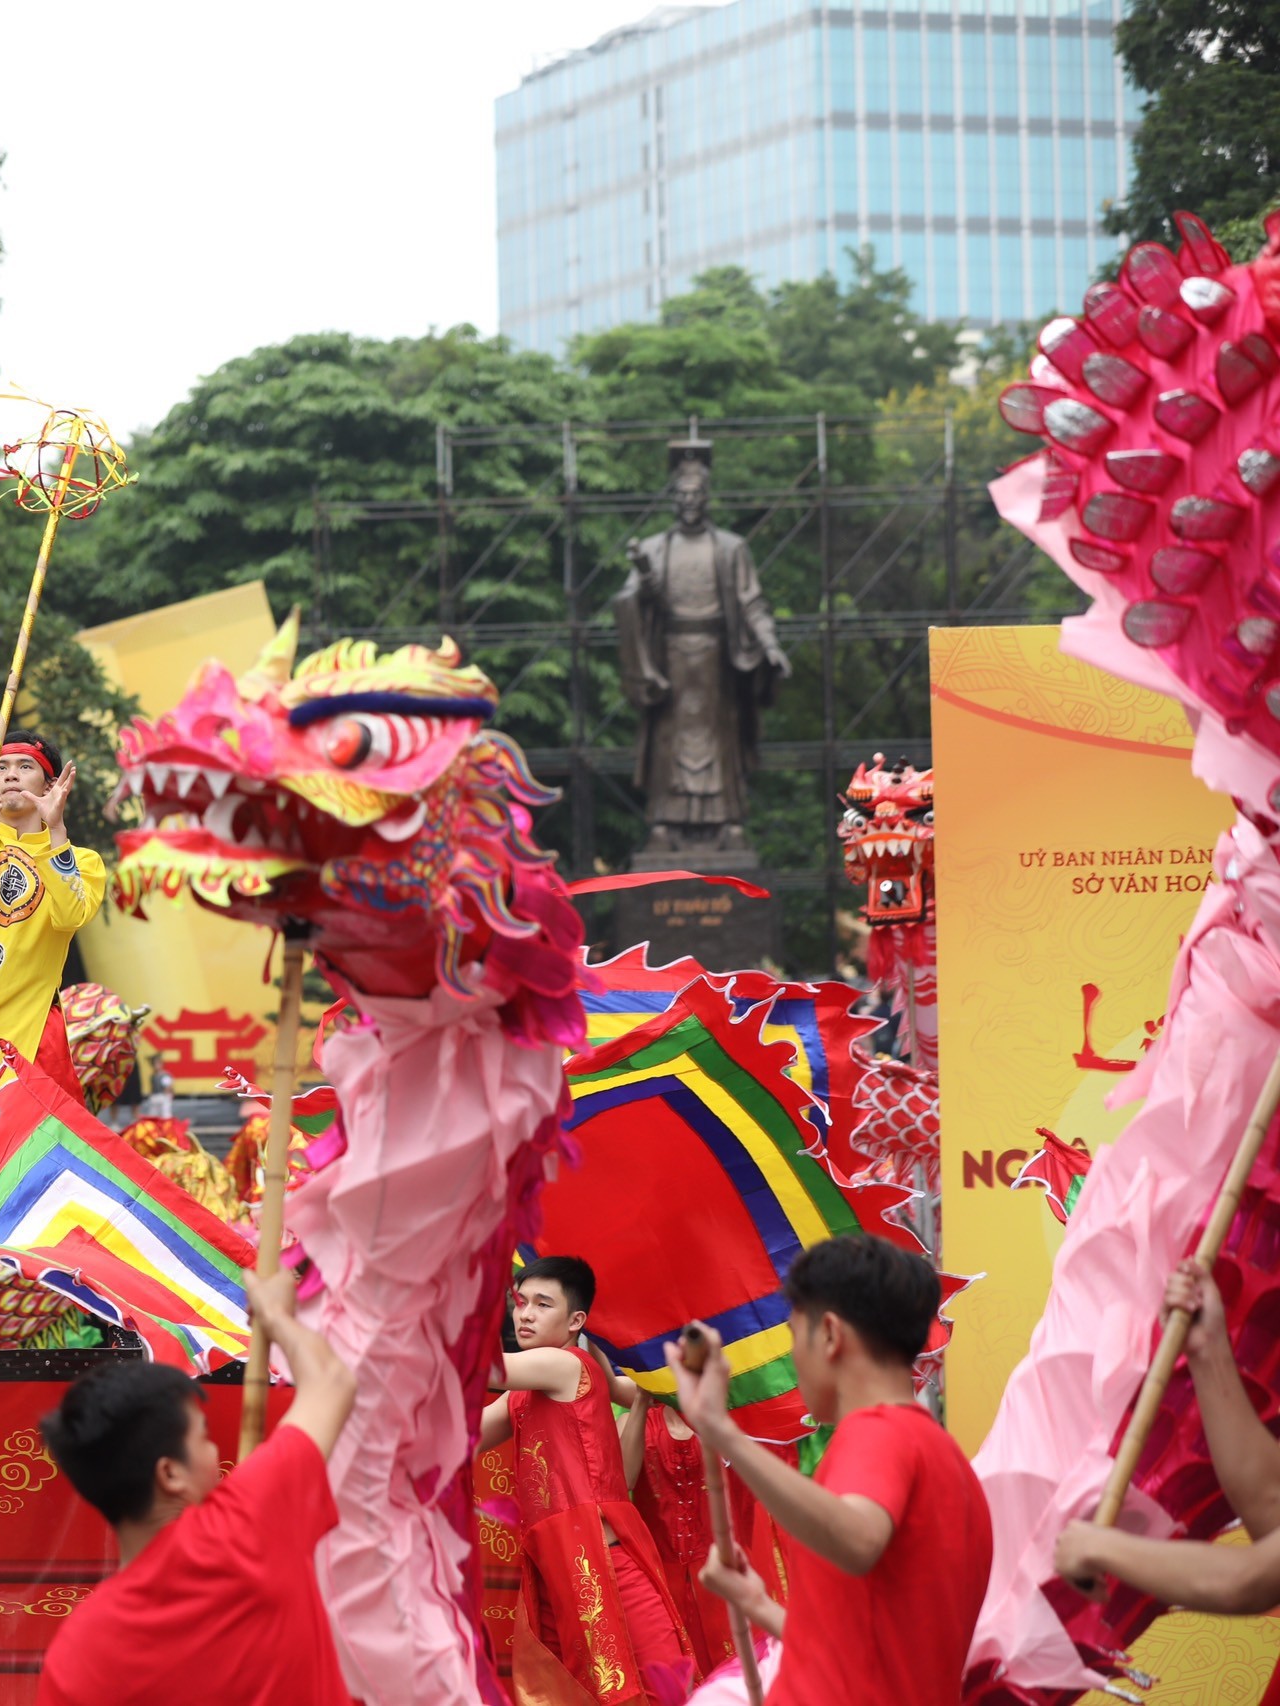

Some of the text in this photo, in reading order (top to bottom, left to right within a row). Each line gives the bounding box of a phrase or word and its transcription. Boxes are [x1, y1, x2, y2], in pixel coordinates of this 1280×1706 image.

[1019, 846, 1214, 868] UỶ BAN NHÂN DÂN
[1072, 872, 1104, 894] SỞ
[1109, 872, 1158, 893] VĂN
